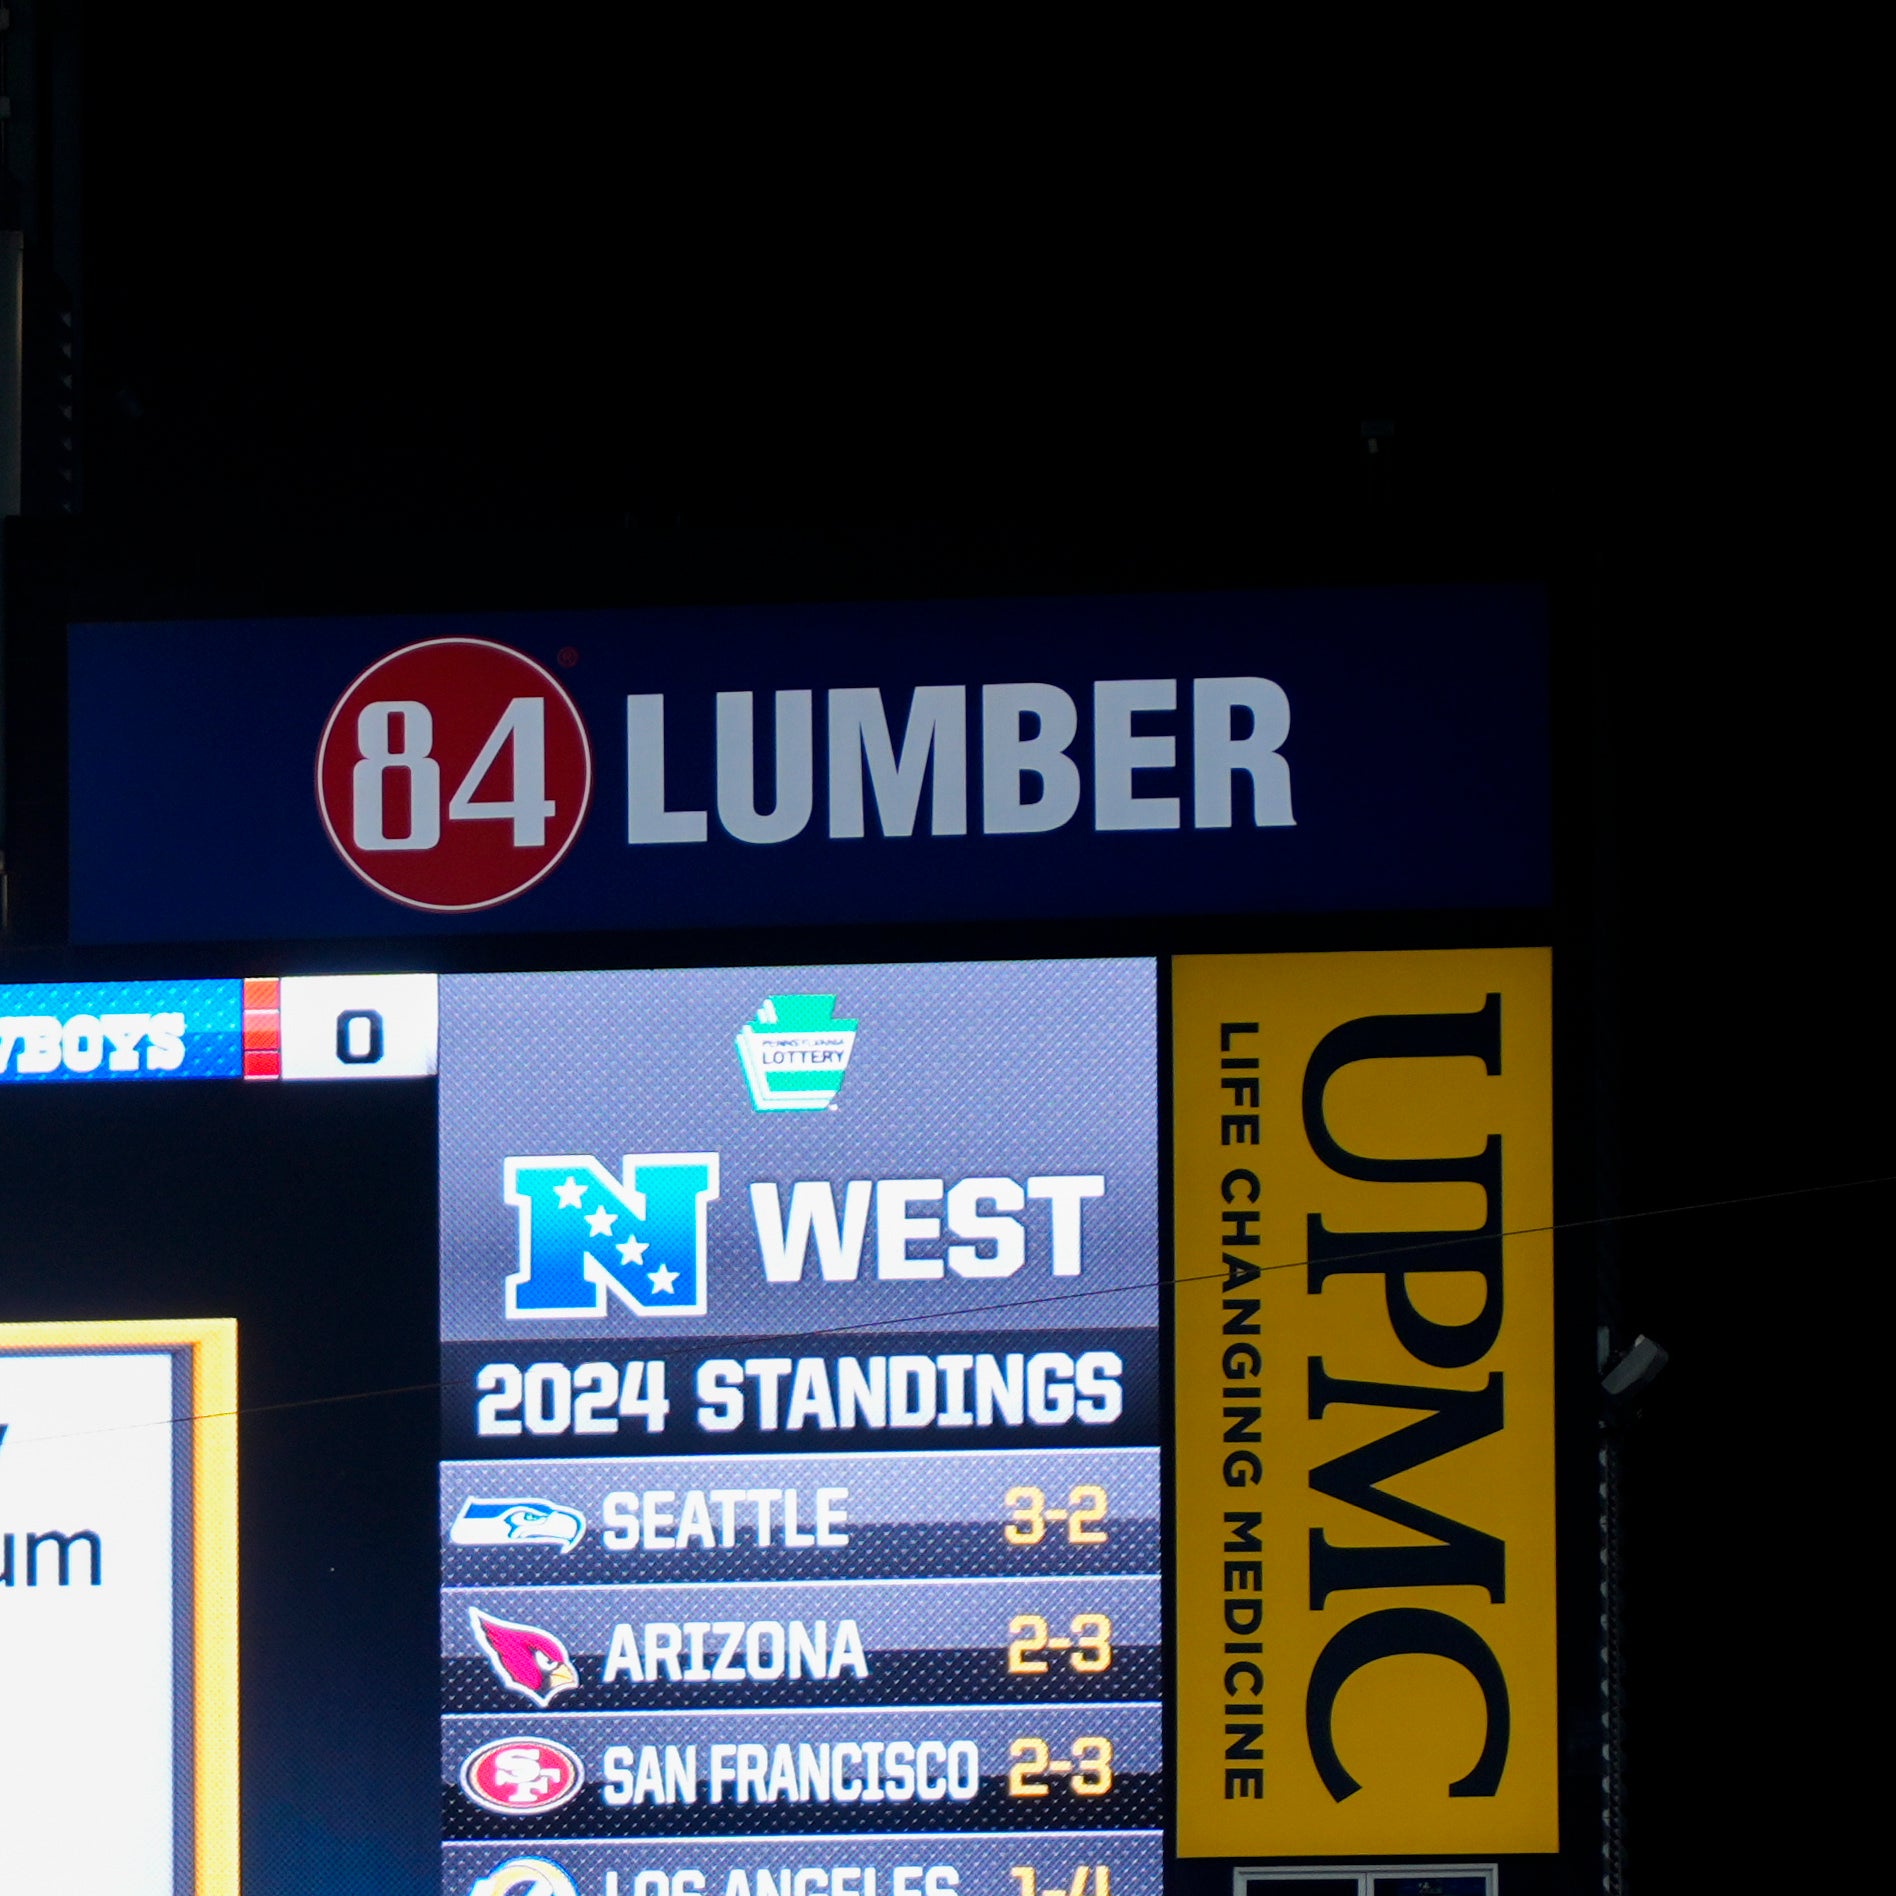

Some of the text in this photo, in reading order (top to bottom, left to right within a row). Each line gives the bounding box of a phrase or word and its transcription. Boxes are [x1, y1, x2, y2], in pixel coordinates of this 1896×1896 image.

[352, 675, 1297, 852] 84 LUMBER
[336, 1009, 384, 1064] 0
[763, 1050, 844, 1065] LOTTERY
[750, 1175, 1105, 1282] WEST
[476, 1352, 1123, 1438] 2024 STANDINGS
[1219, 1022, 1263, 1802] LIFE CHANGING MEDICINE
[1302, 994, 1511, 1805] UPMC
[604, 1486, 1110, 1551] SEATTLE 3-2
[604, 1613, 1113, 1684] ARIZONA 2-3
[604, 1737, 1113, 1804] SAN FRANCISCO 2-3
